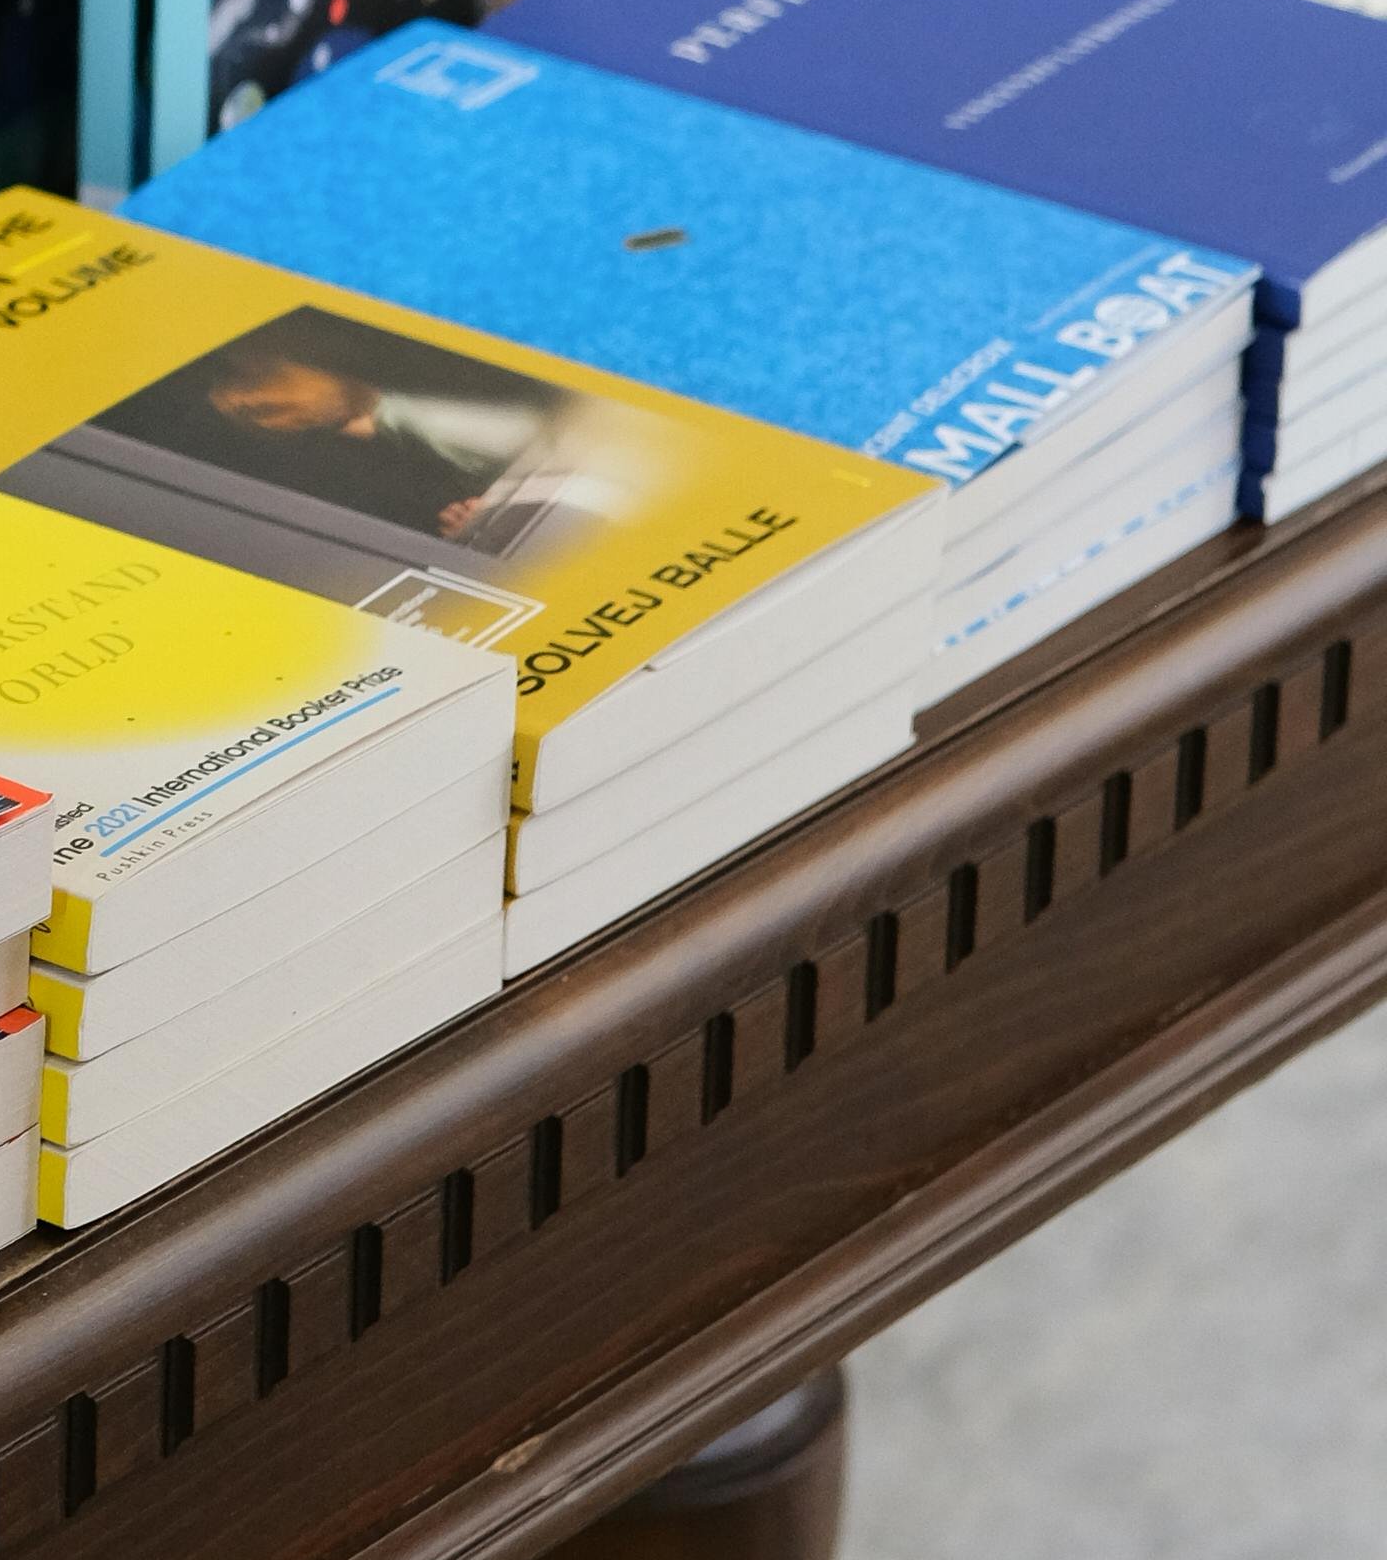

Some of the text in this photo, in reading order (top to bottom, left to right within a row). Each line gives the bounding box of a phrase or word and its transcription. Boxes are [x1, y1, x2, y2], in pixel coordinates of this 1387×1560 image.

[1056, 251, 1233, 360] BOAT
[517, 506, 799, 697] SOLVEJ BALLE
[83, 796, 147, 839] 2021
[133, 726, 281, 809] International
[265, 688, 355, 732] Booker
[342, 665, 405, 694] Prize
[95, 811, 214, 881] Pushkin Press
